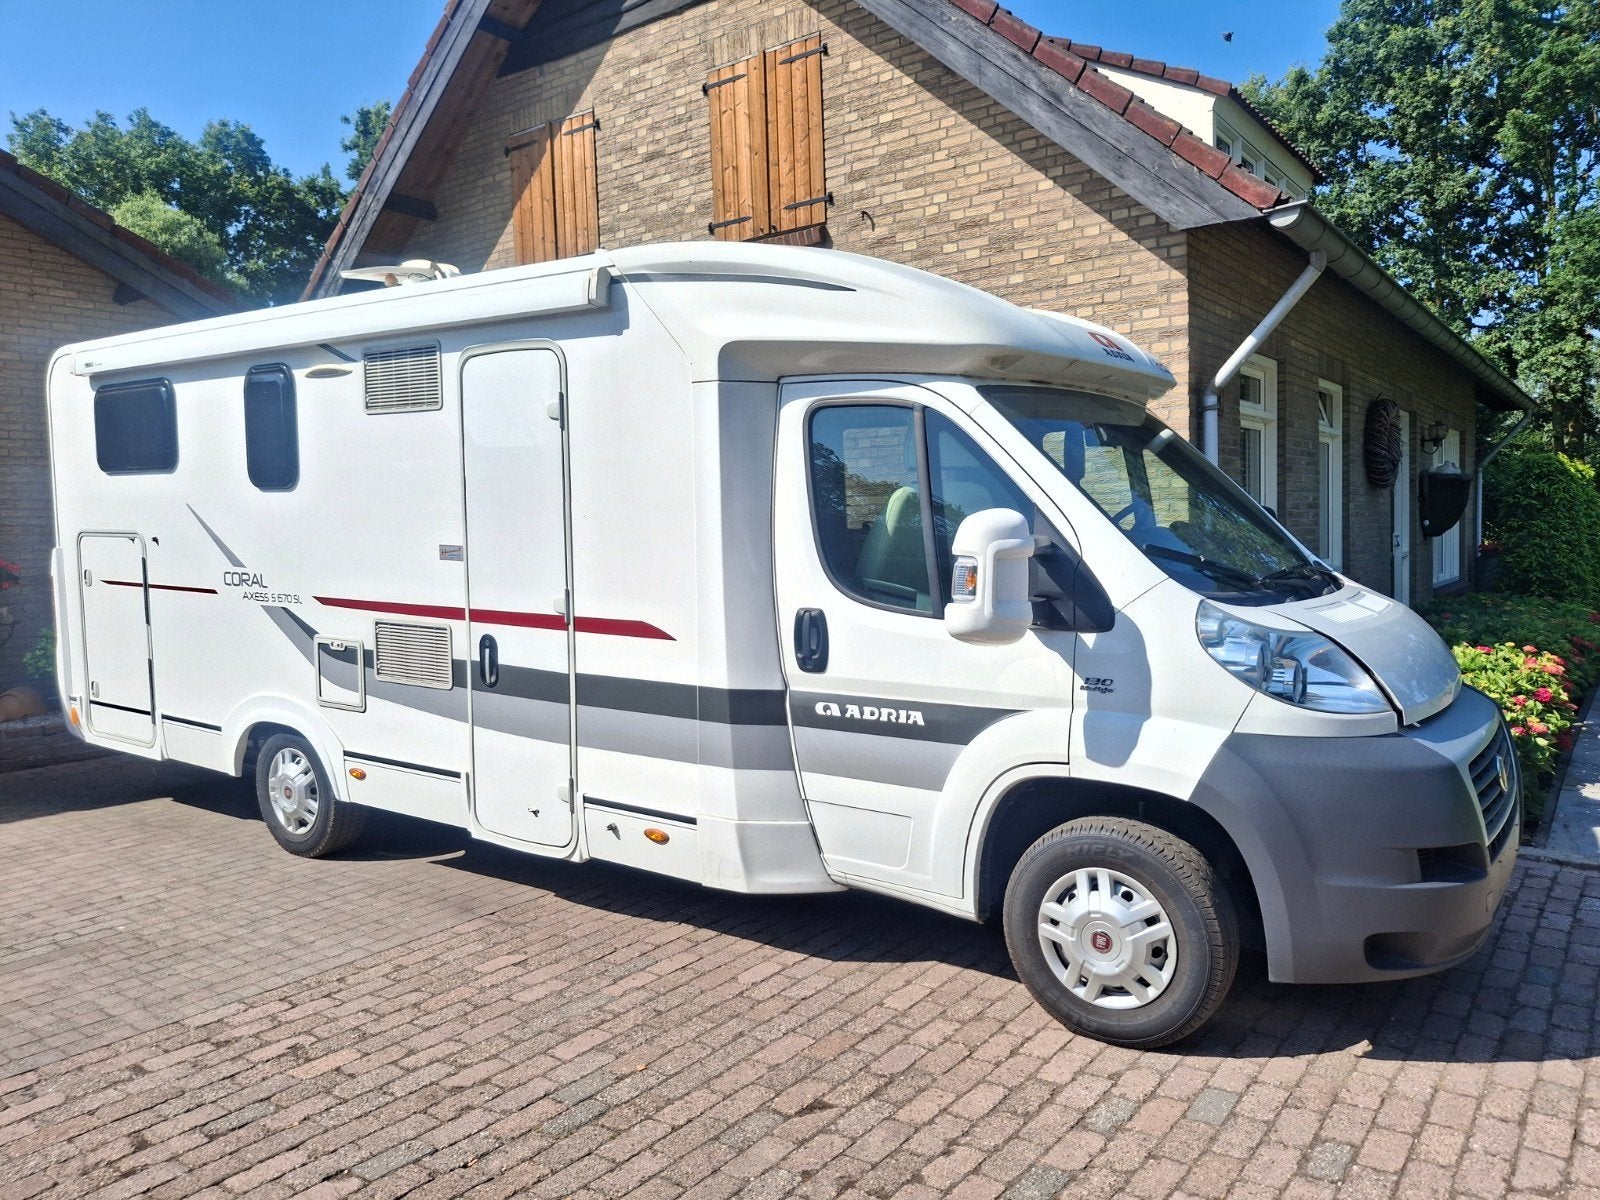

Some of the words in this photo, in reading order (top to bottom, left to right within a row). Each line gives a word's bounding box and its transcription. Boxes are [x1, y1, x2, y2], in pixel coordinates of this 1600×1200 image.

[223, 571, 268, 589] CORAL
[242, 591, 270, 603] AXESS
[277, 593, 293, 604] 670
[293, 594, 303, 605] SL
[1084, 677, 1114, 687] 130
[845, 704, 925, 726] ADRIA
